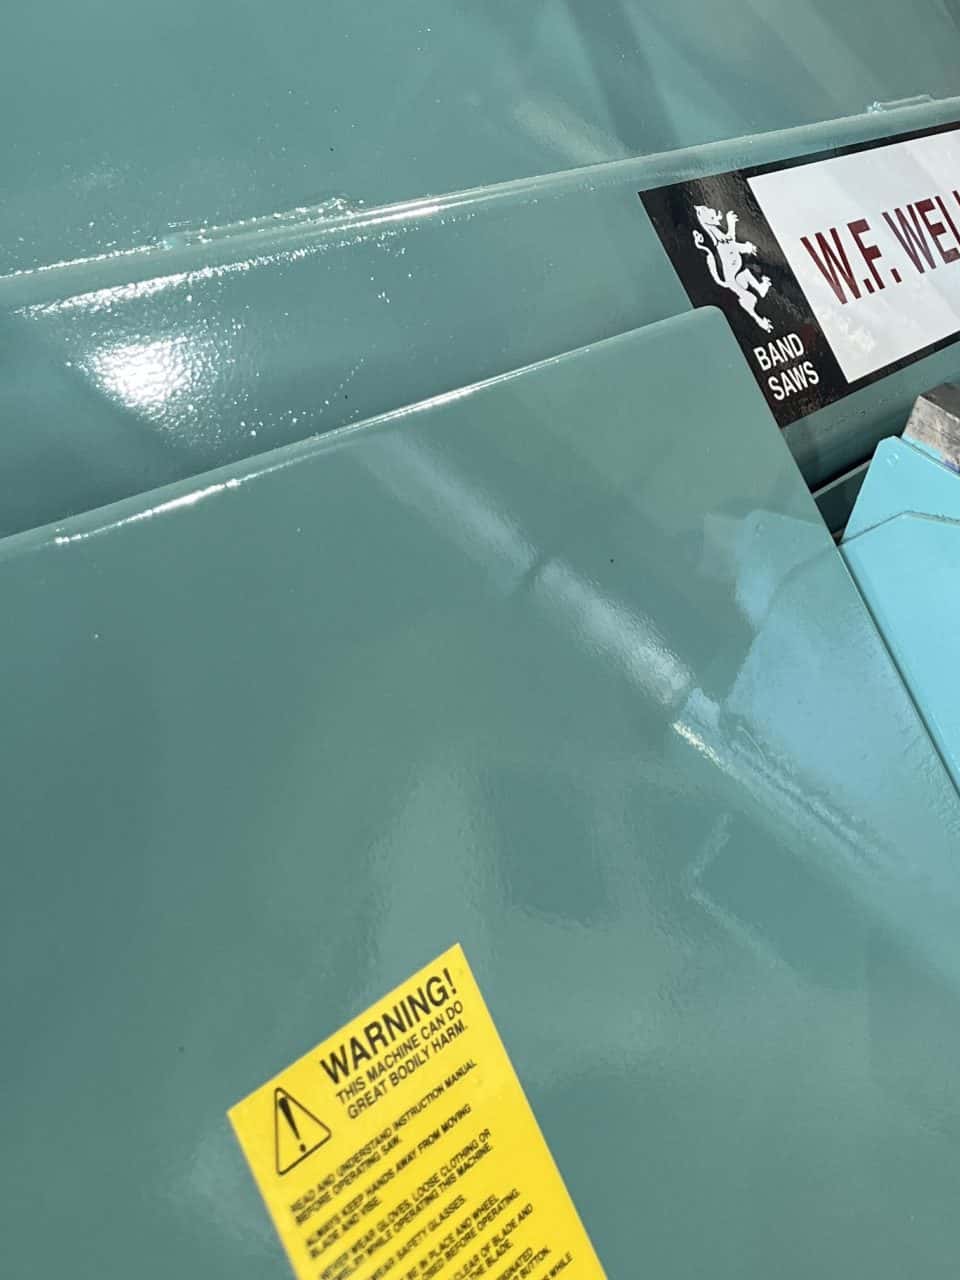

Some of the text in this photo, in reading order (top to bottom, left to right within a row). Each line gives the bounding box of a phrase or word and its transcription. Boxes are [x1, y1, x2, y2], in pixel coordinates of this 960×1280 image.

[754, 333, 804, 372] BAND
[768, 361, 820, 401] SAWS
[320, 968, 456, 1084] WARNING!
[336, 1000, 463, 1104] THIS MACHINE CAN DO
[348, 1079, 387, 1119] GREAT
[389, 1045, 429, 1087] BODILY
[393, 1085, 444, 1130] INSTRUCTION
[445, 1060, 476, 1088] MANUAL
[418, 1129, 441, 1153] FROM
